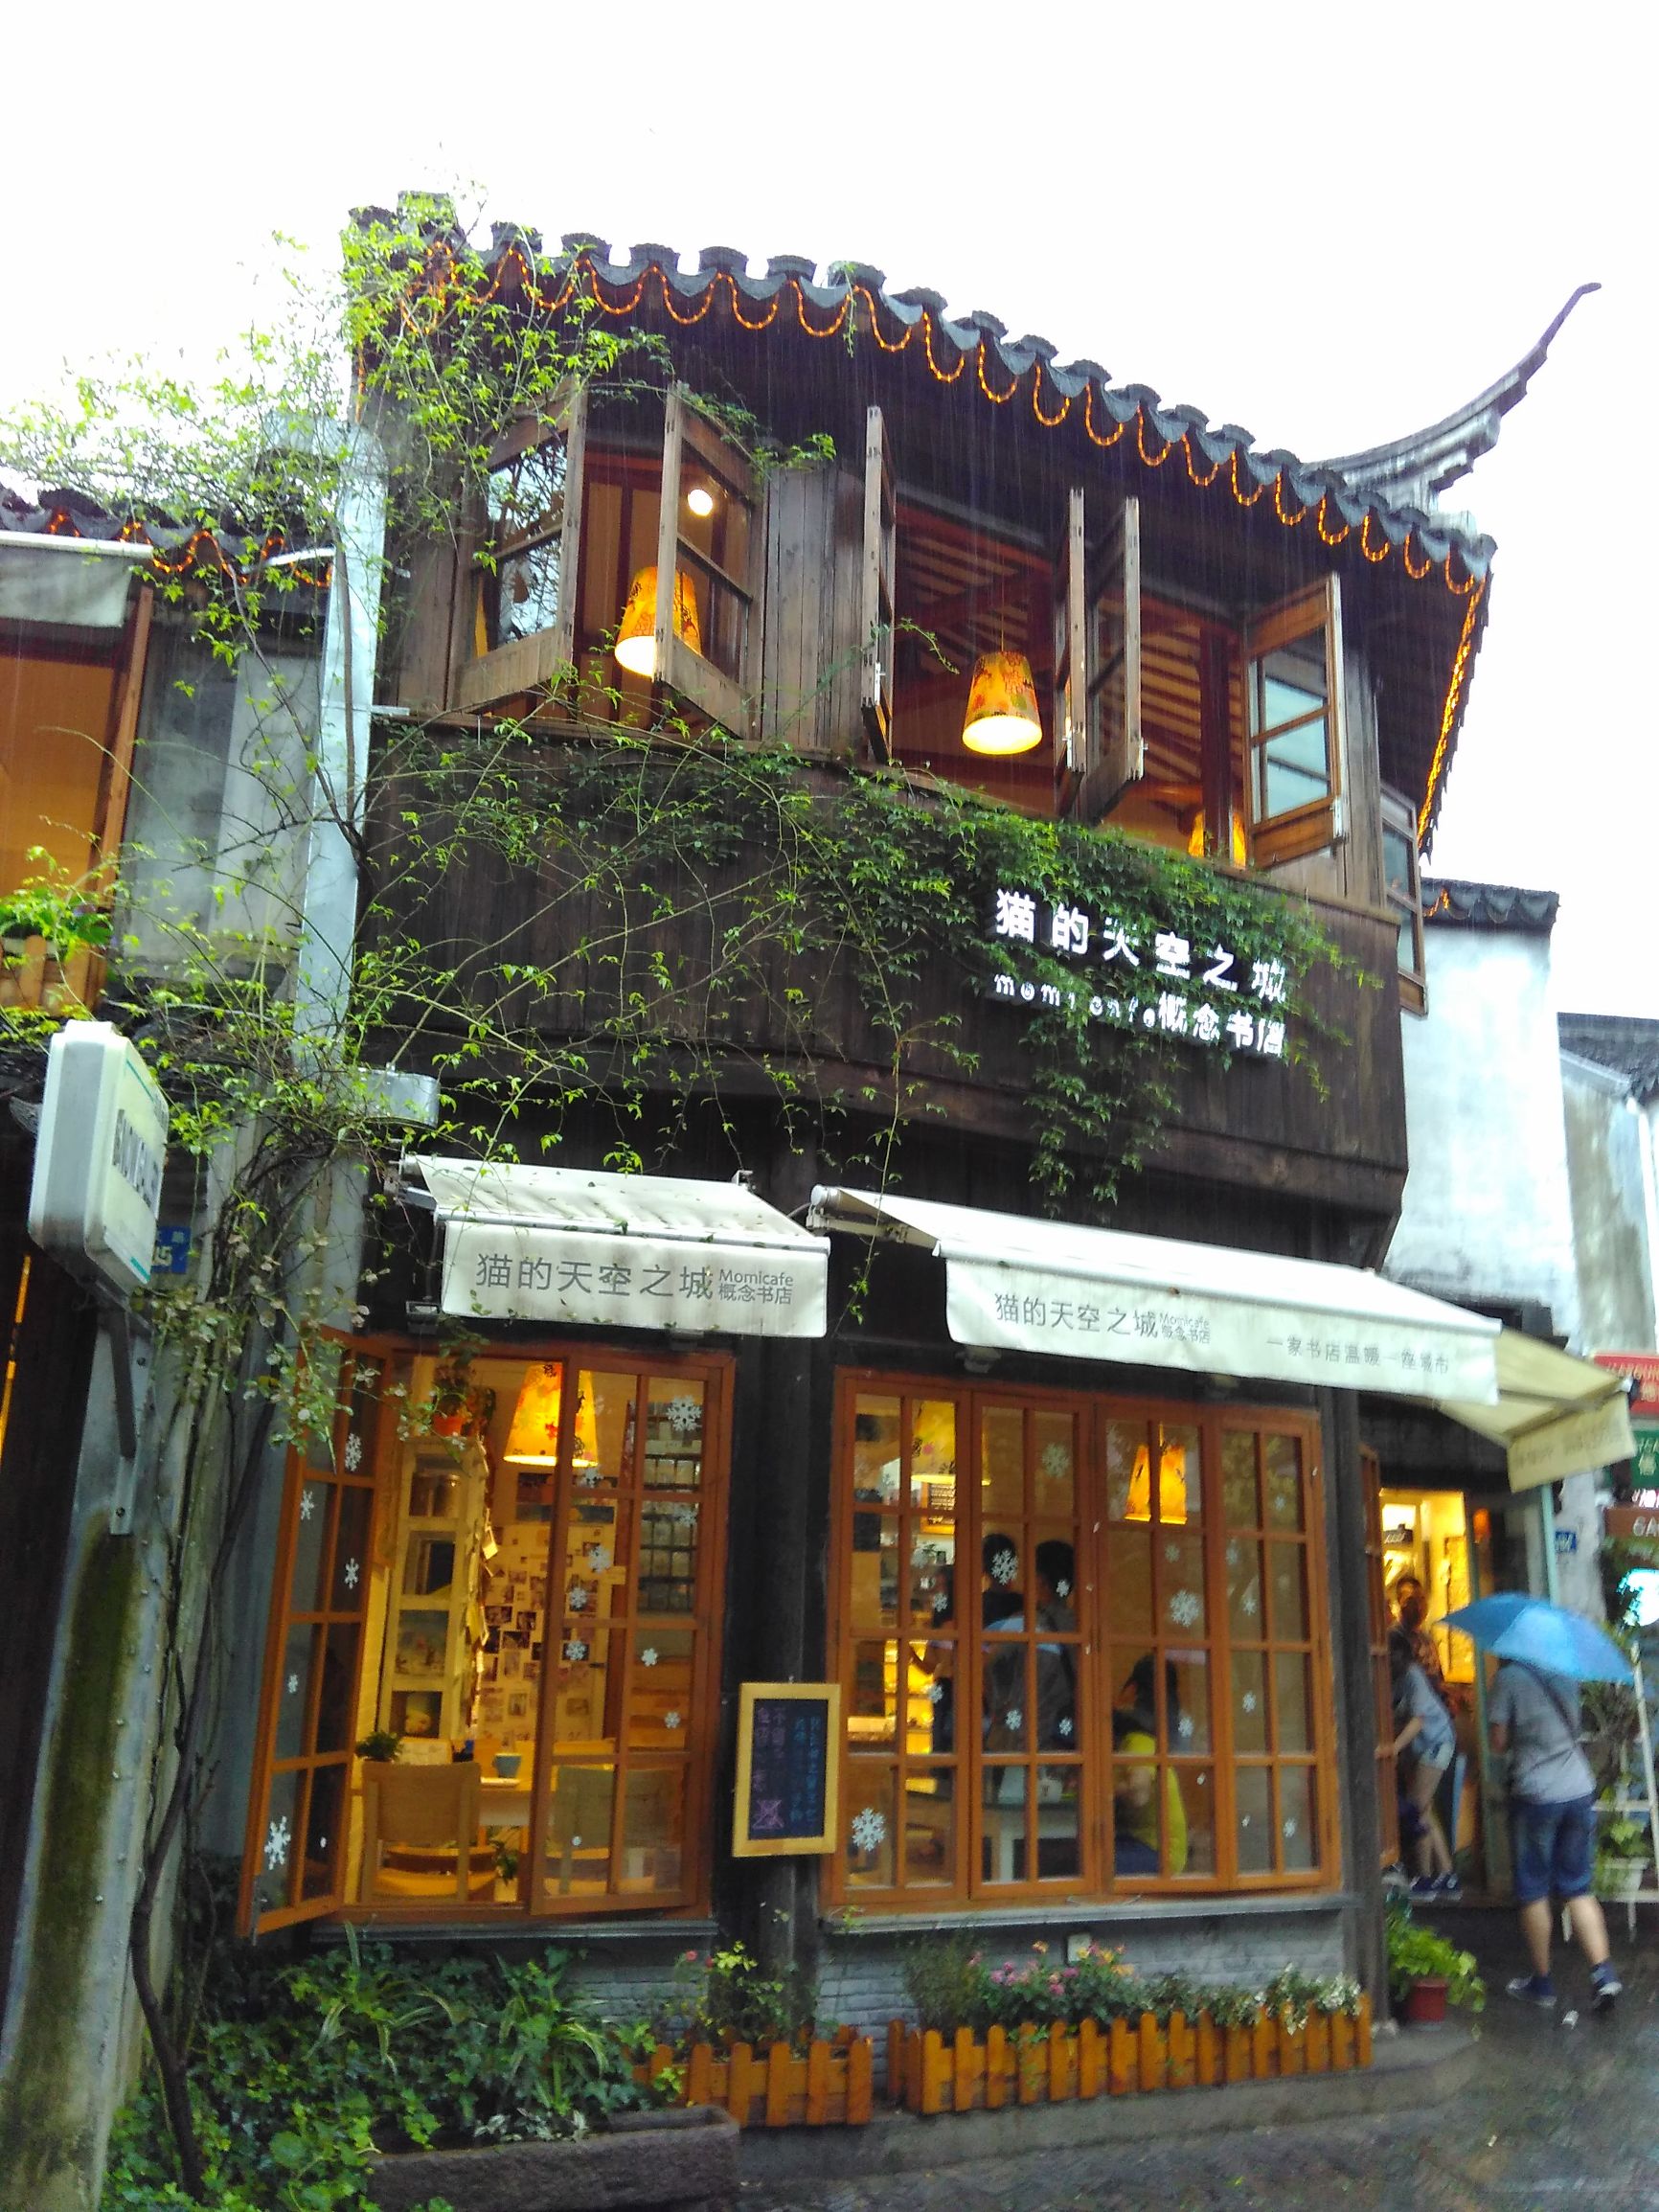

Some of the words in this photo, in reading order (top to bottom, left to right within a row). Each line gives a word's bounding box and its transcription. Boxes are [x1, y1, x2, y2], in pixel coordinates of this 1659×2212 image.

[996, 888, 1286, 1003] 猫的天空之城
[1158, 991, 1285, 1058] 概念书店
[476, 1252, 715, 1301] 猫的天空之城
[717, 1284, 793, 1305] 概念书店
[718, 1268, 794, 1287] Momicafe
[994, 1292, 1159, 1339] 猫的天空之城
[1159, 1311, 1211, 1330] Momicafe
[1161, 1324, 1211, 1344] 概念书店
[1265, 1334, 1449, 1376] 一家书店温暖一座城市
